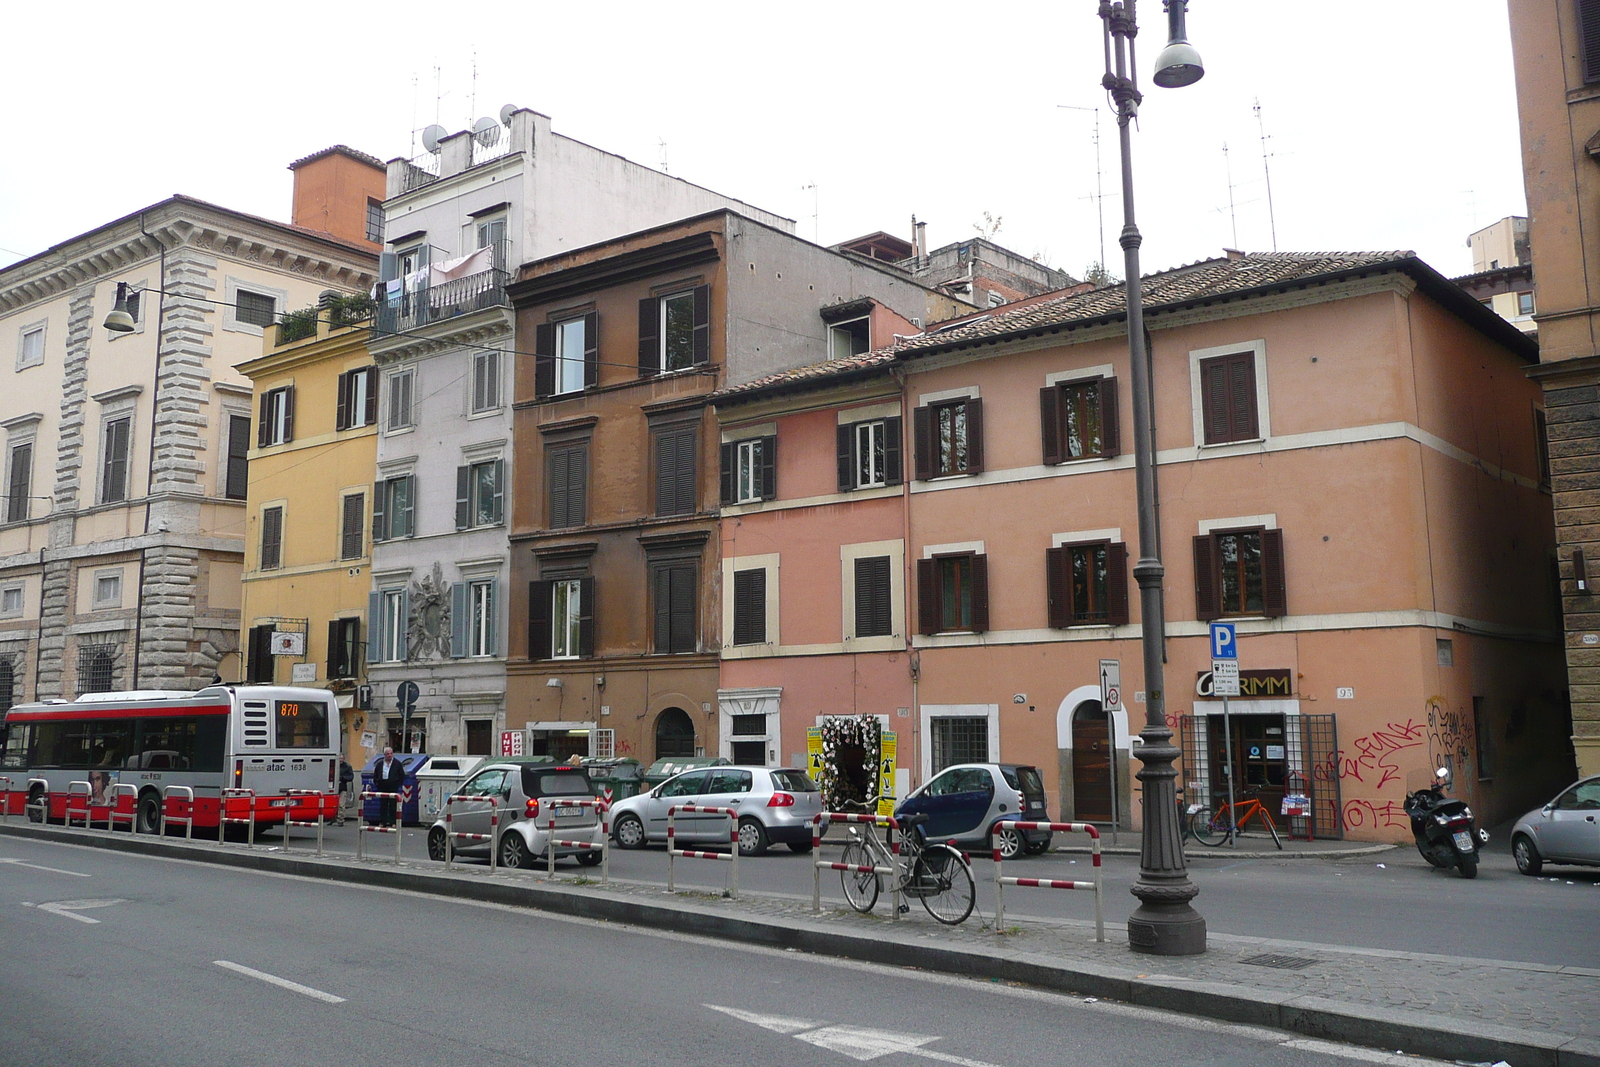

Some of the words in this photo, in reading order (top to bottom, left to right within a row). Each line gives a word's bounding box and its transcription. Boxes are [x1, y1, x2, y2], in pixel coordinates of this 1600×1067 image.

[1215, 627, 1231, 655] P
[281, 704, 298, 716] 870
[266, 763, 285, 771] atac
